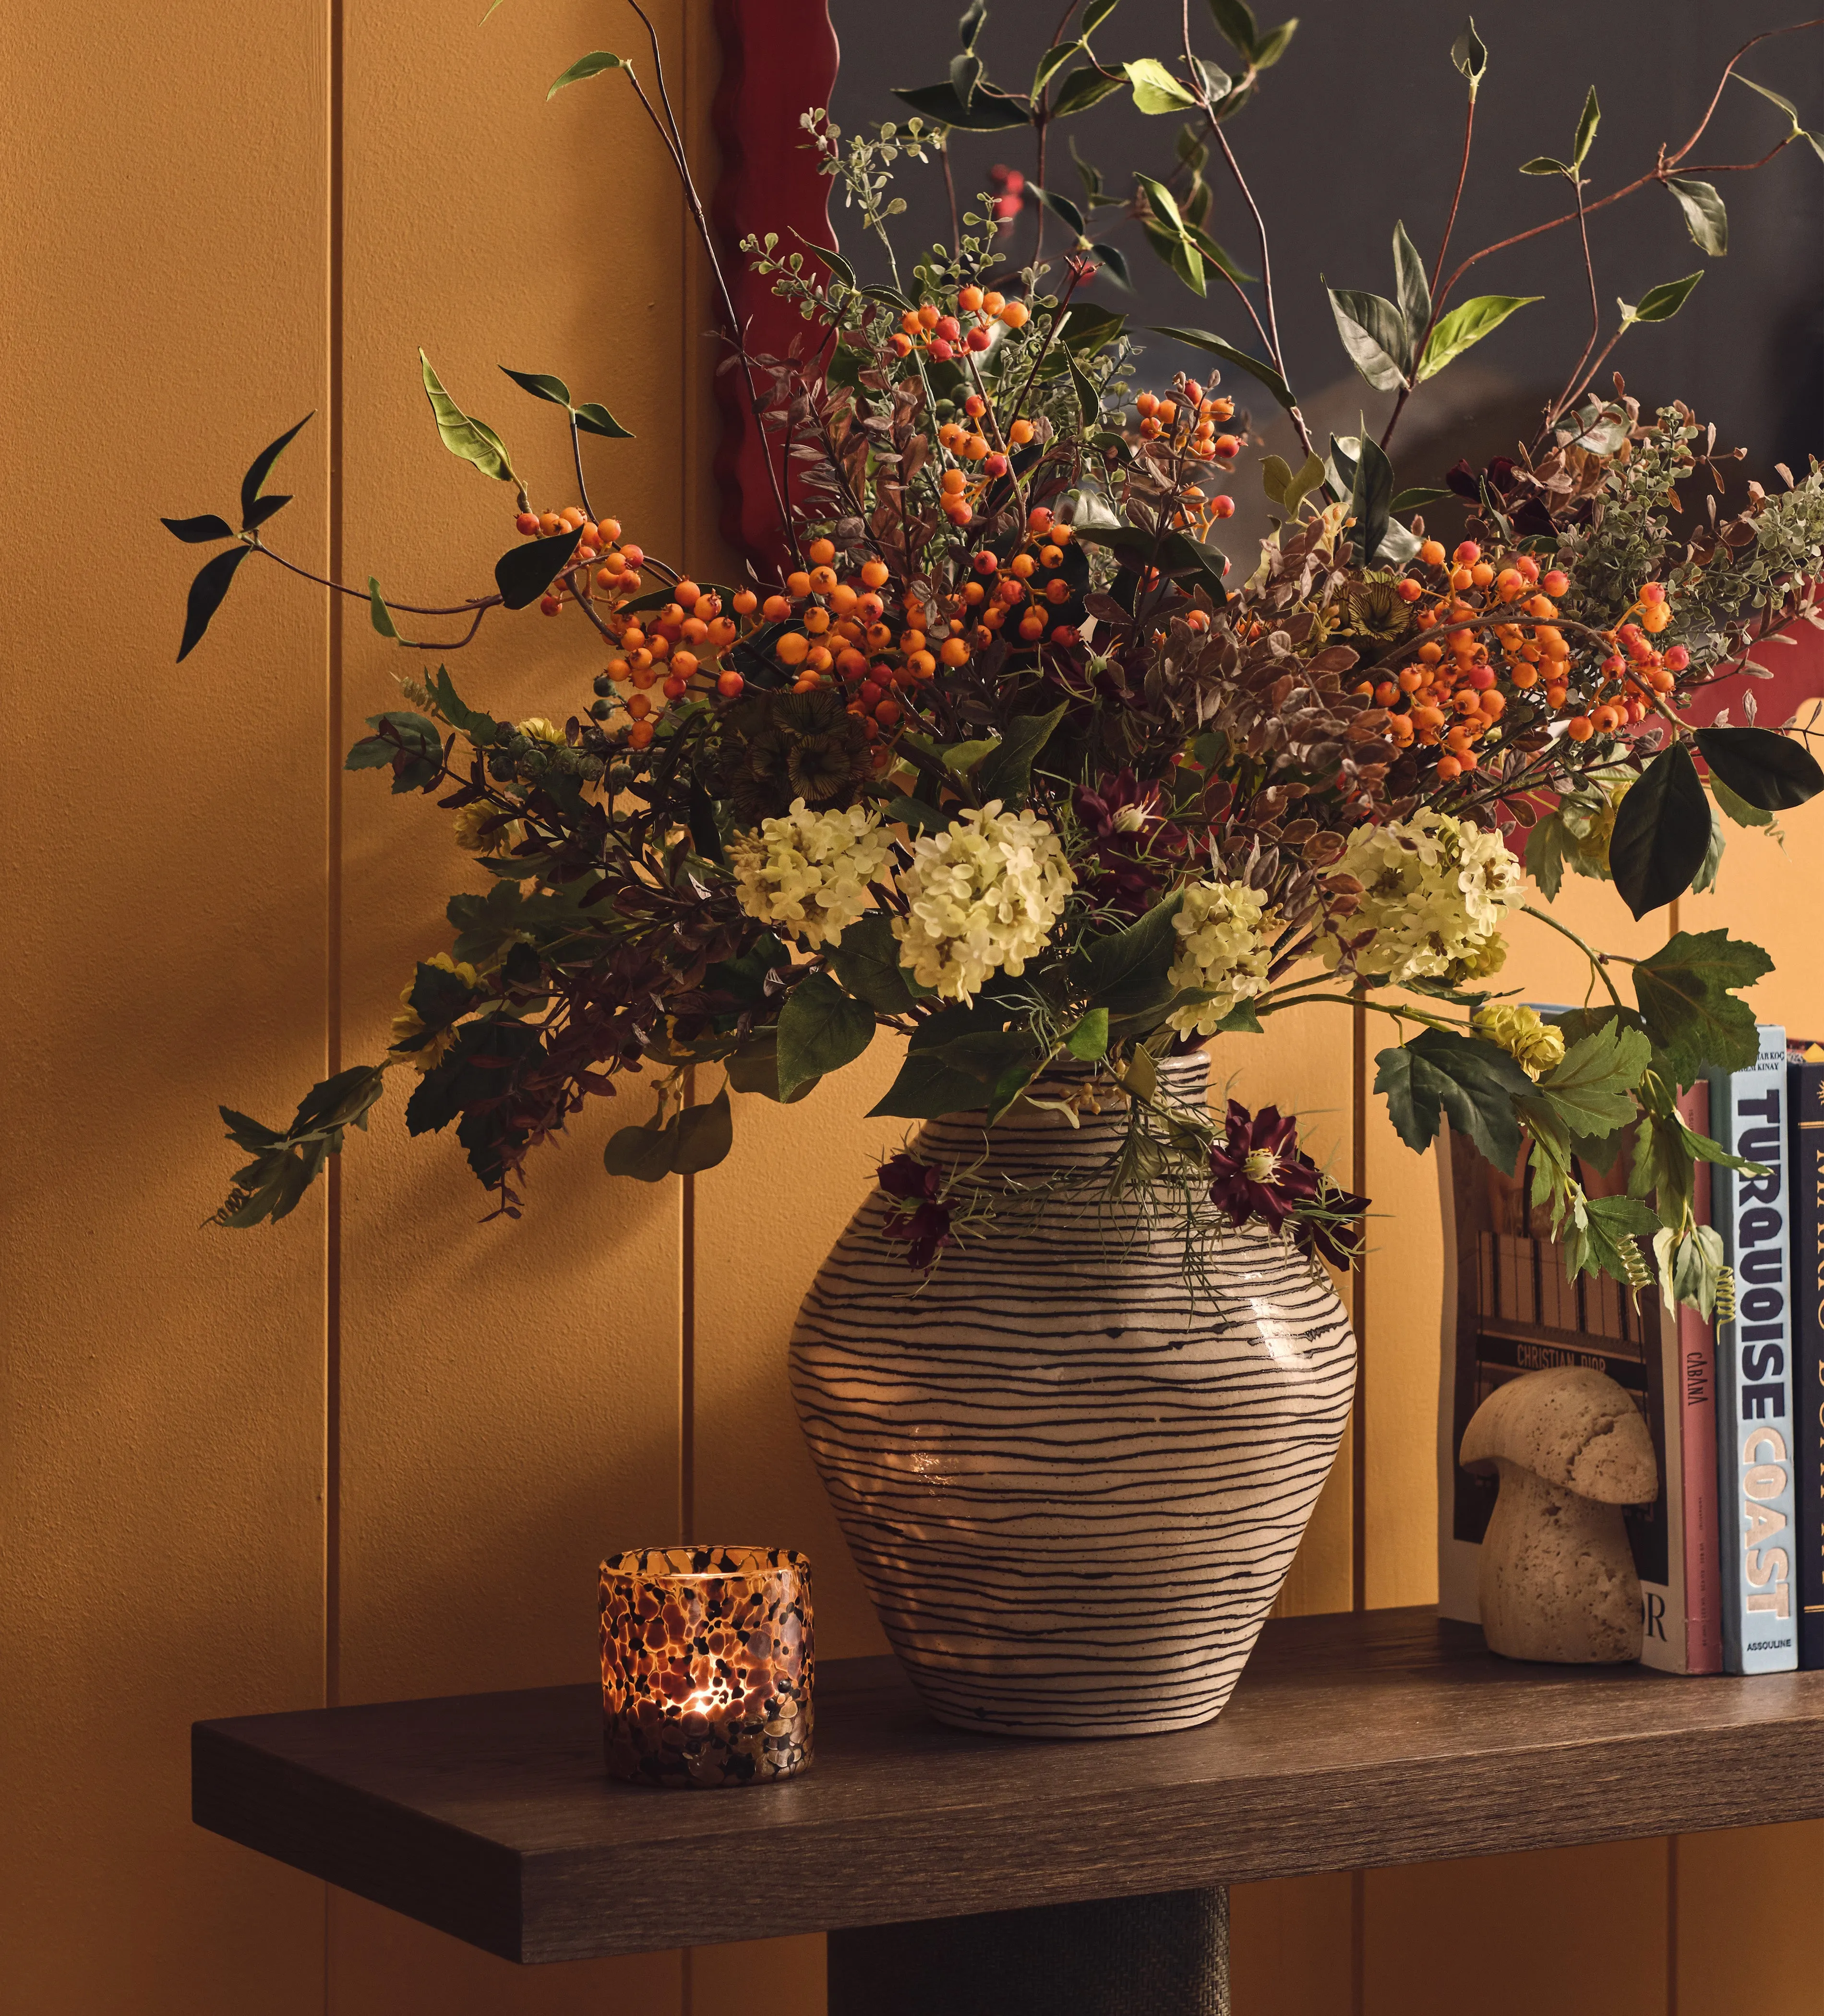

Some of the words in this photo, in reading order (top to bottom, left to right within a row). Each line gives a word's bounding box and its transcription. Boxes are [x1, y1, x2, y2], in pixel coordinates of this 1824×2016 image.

[1758, 1063, 1779, 1071] KINAY
[1770, 1051, 1785, 1061] KOÇ
[1737, 1089, 1785, 1420] TURQUOISE
[1517, 1344, 1574, 1368] CHRISTIAN
[1581, 1355, 1606, 1373] DIOR
[1687, 1353, 1708, 1406] CABANA
[1743, 1426, 1790, 1620] COAST
[1747, 1639, 1791, 1651] ASSOULINE
